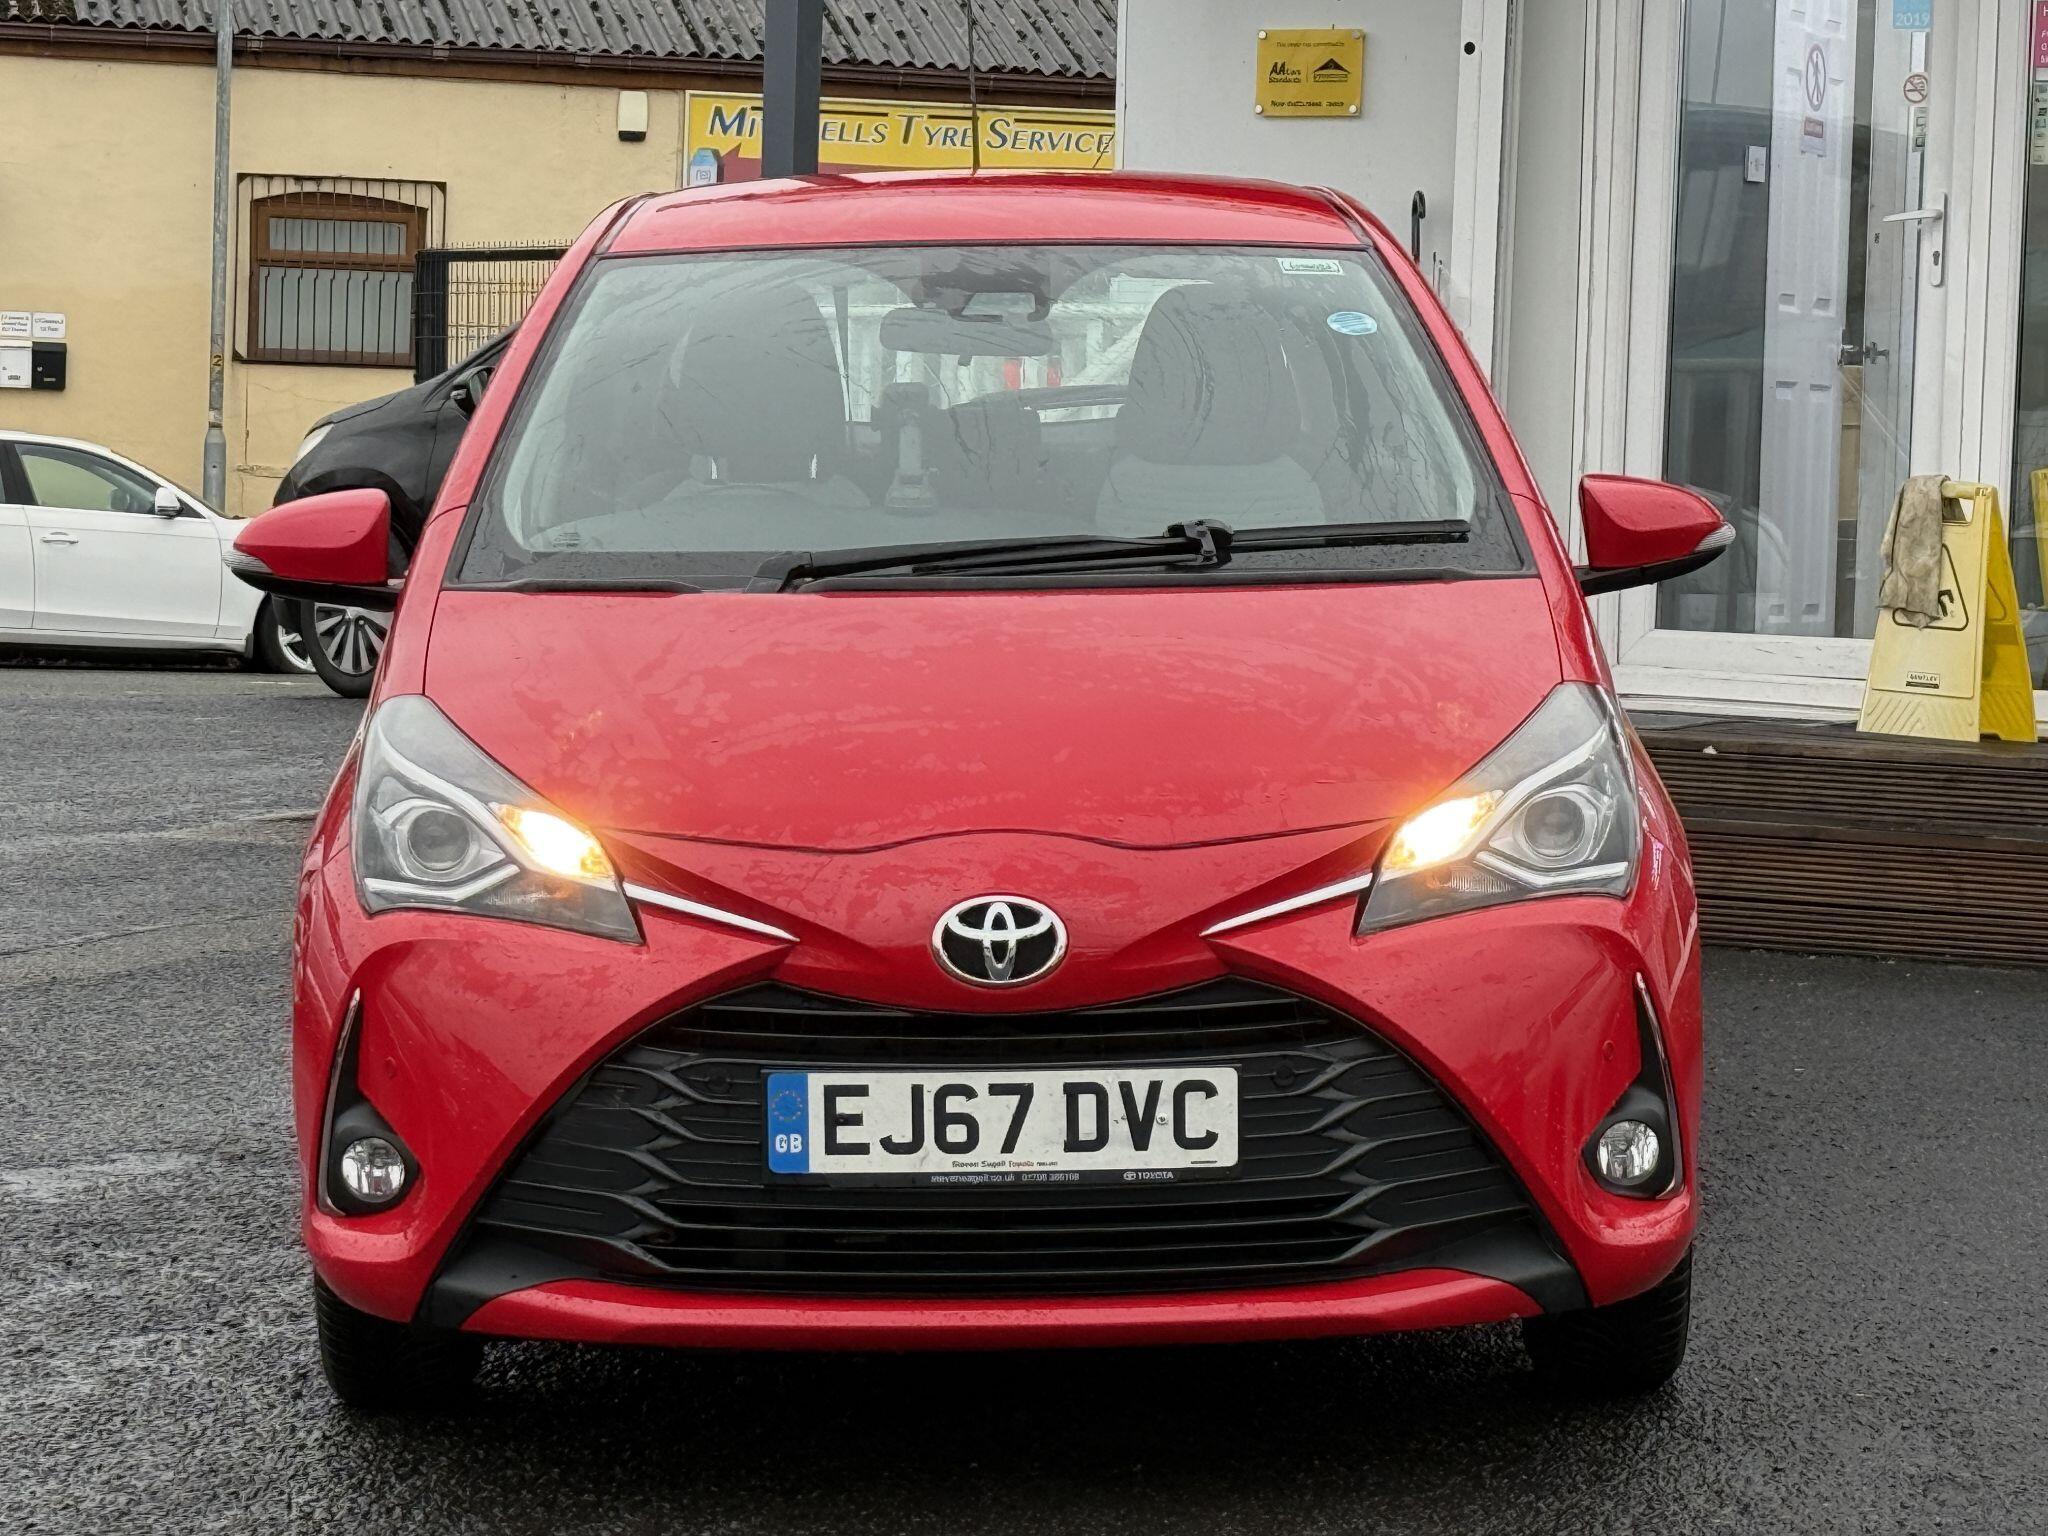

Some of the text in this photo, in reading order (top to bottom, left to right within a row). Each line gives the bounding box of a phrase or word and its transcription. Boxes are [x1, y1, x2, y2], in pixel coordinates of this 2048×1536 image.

[709, 105, 1115, 154] MIELLS TYRE SERVICE
[823, 1079, 1219, 1156] EJ67 DVC
[775, 1133, 802, 1153] GB
[1137, 1170, 1174, 1180] TOYOTA
